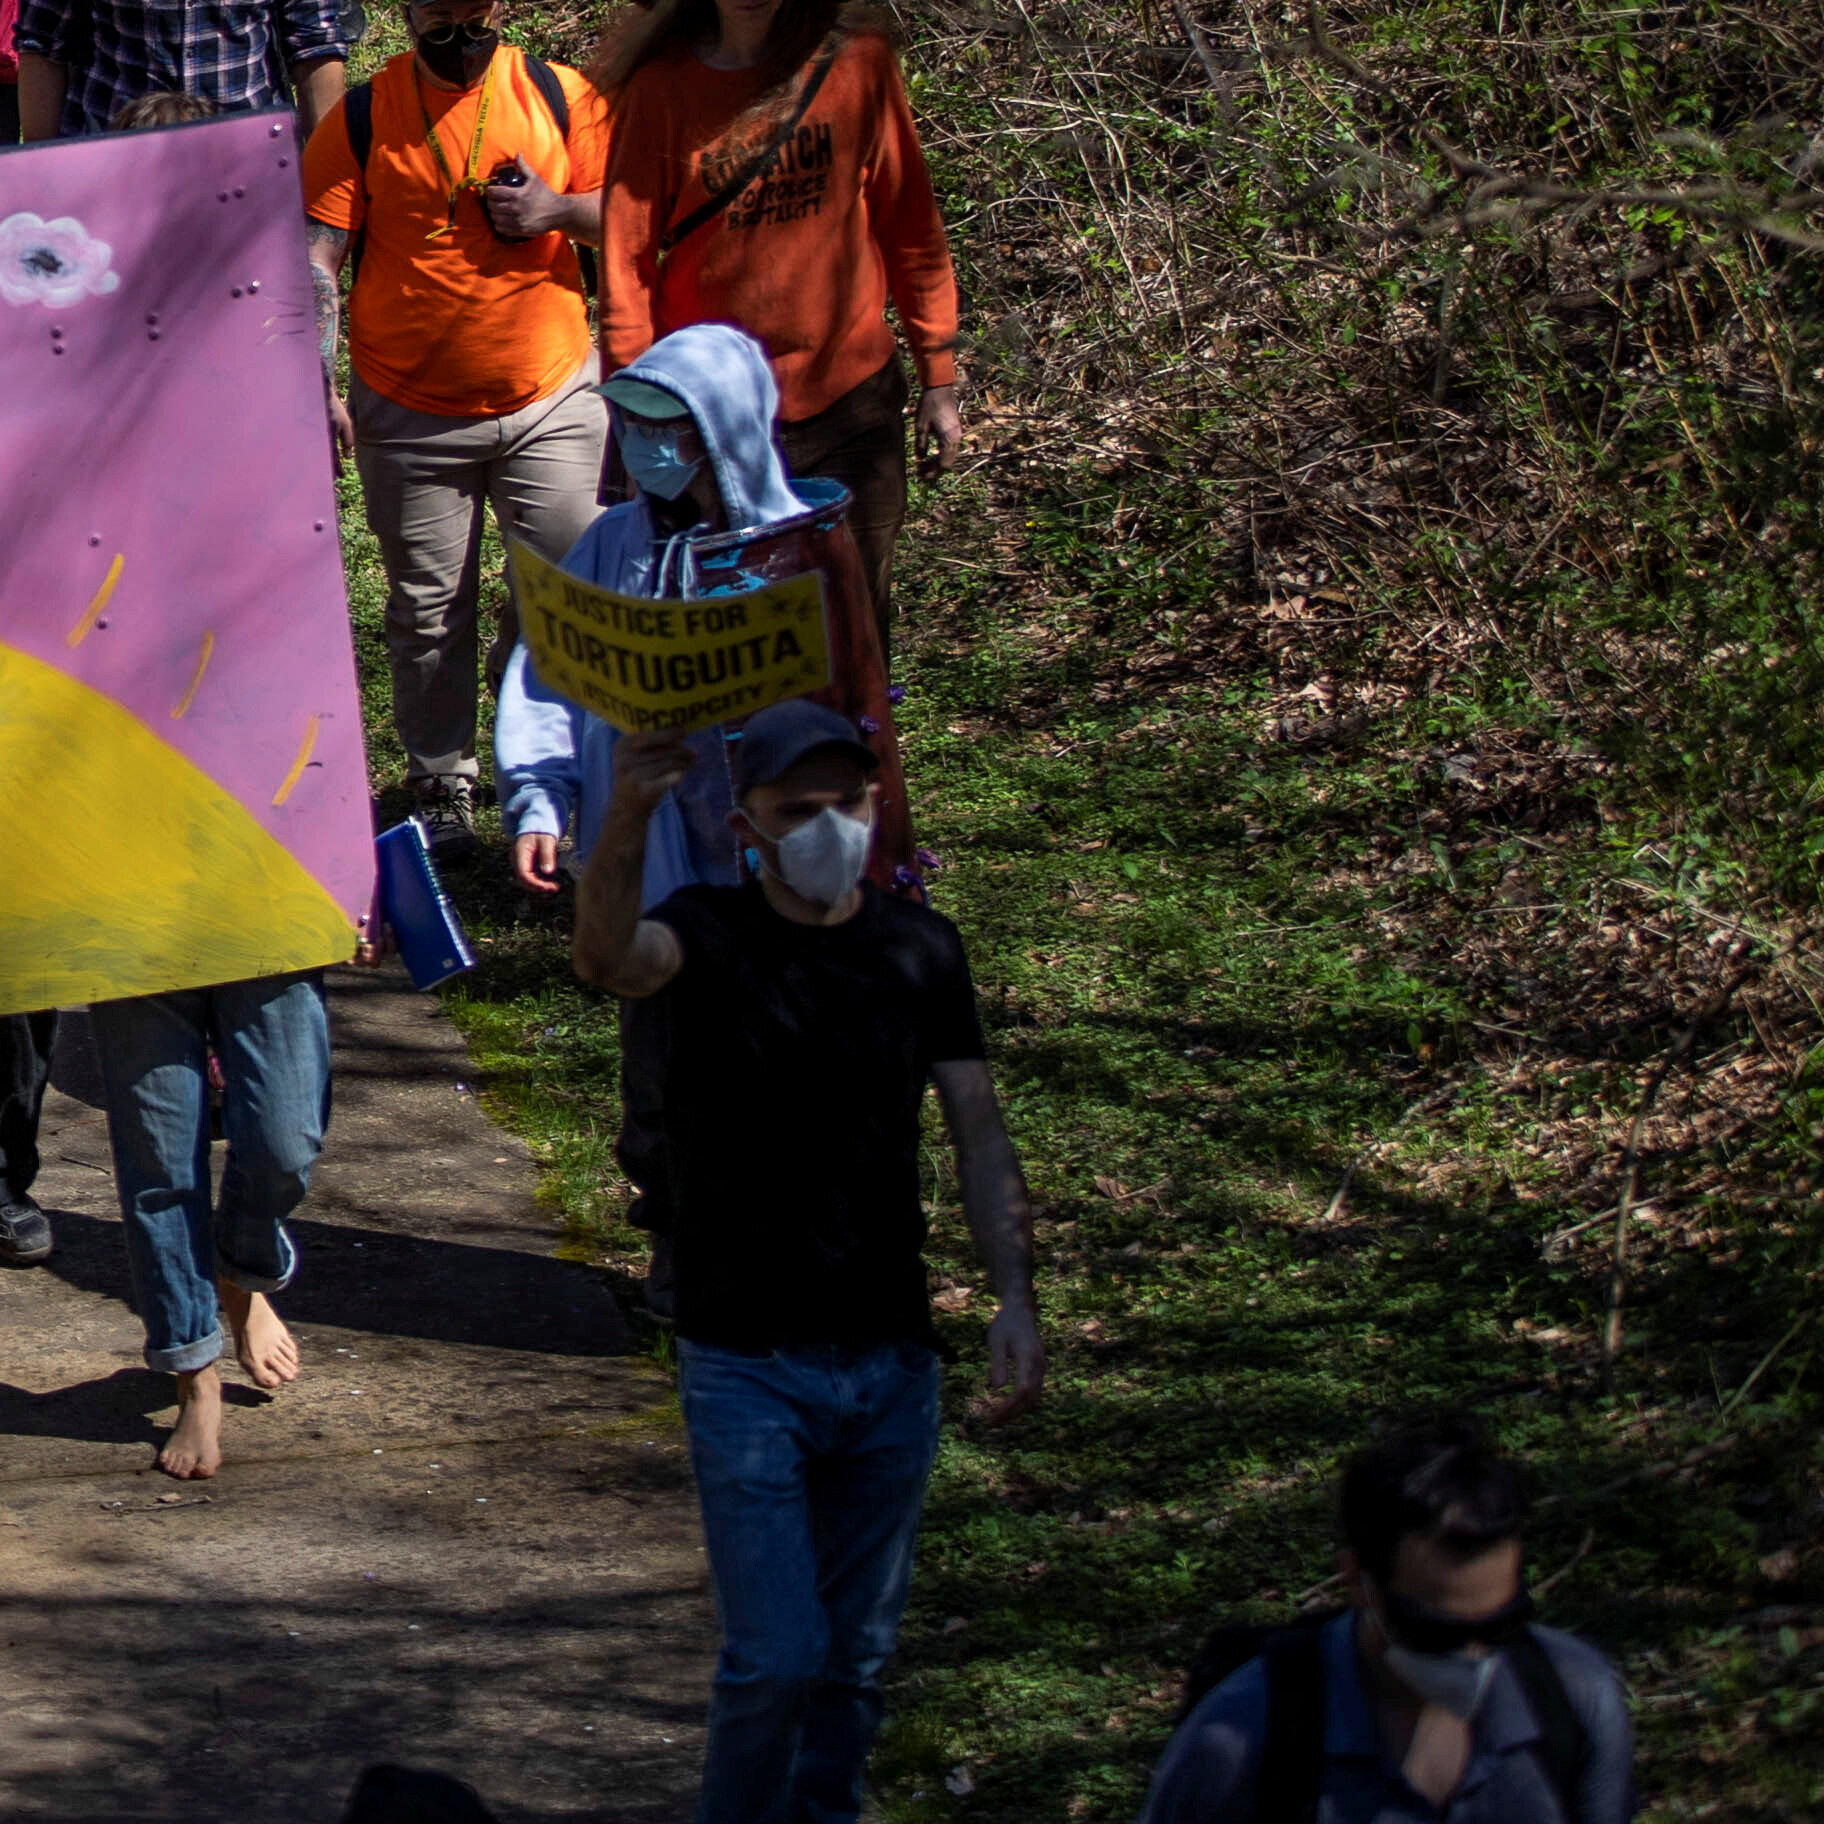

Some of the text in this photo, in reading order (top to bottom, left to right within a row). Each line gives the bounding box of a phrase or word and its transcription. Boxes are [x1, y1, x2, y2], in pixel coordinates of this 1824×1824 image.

[564, 582, 748, 639] JUSTICE FOR
[536, 605, 801, 694] TORTUGUITA
